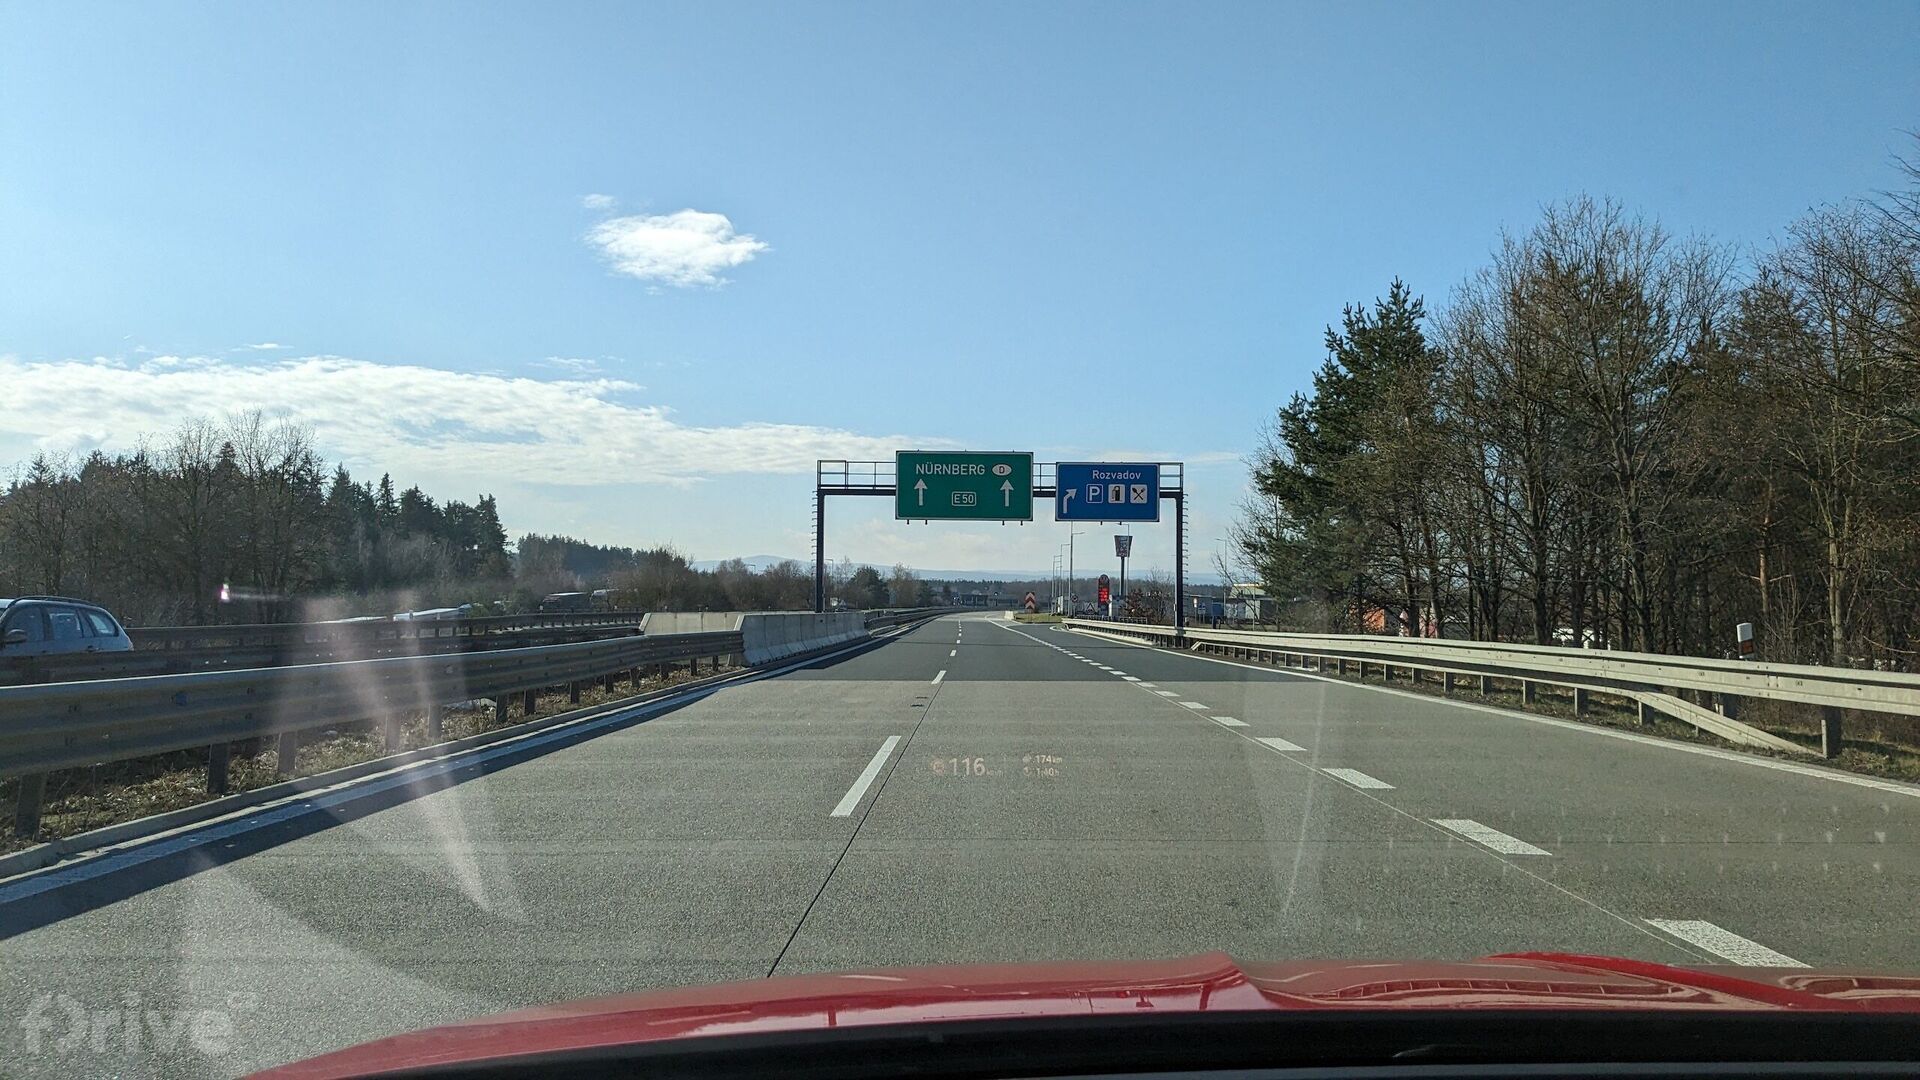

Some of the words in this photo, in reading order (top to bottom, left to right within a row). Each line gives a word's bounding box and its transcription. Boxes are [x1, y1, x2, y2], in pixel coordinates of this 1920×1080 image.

[915, 462, 985, 476] NÜRNBERG
[998, 465, 1006, 474] D
[1093, 470, 1141, 481] Rozvadov
[1089, 486, 1101, 501] P
[949, 757, 986, 777] 116
